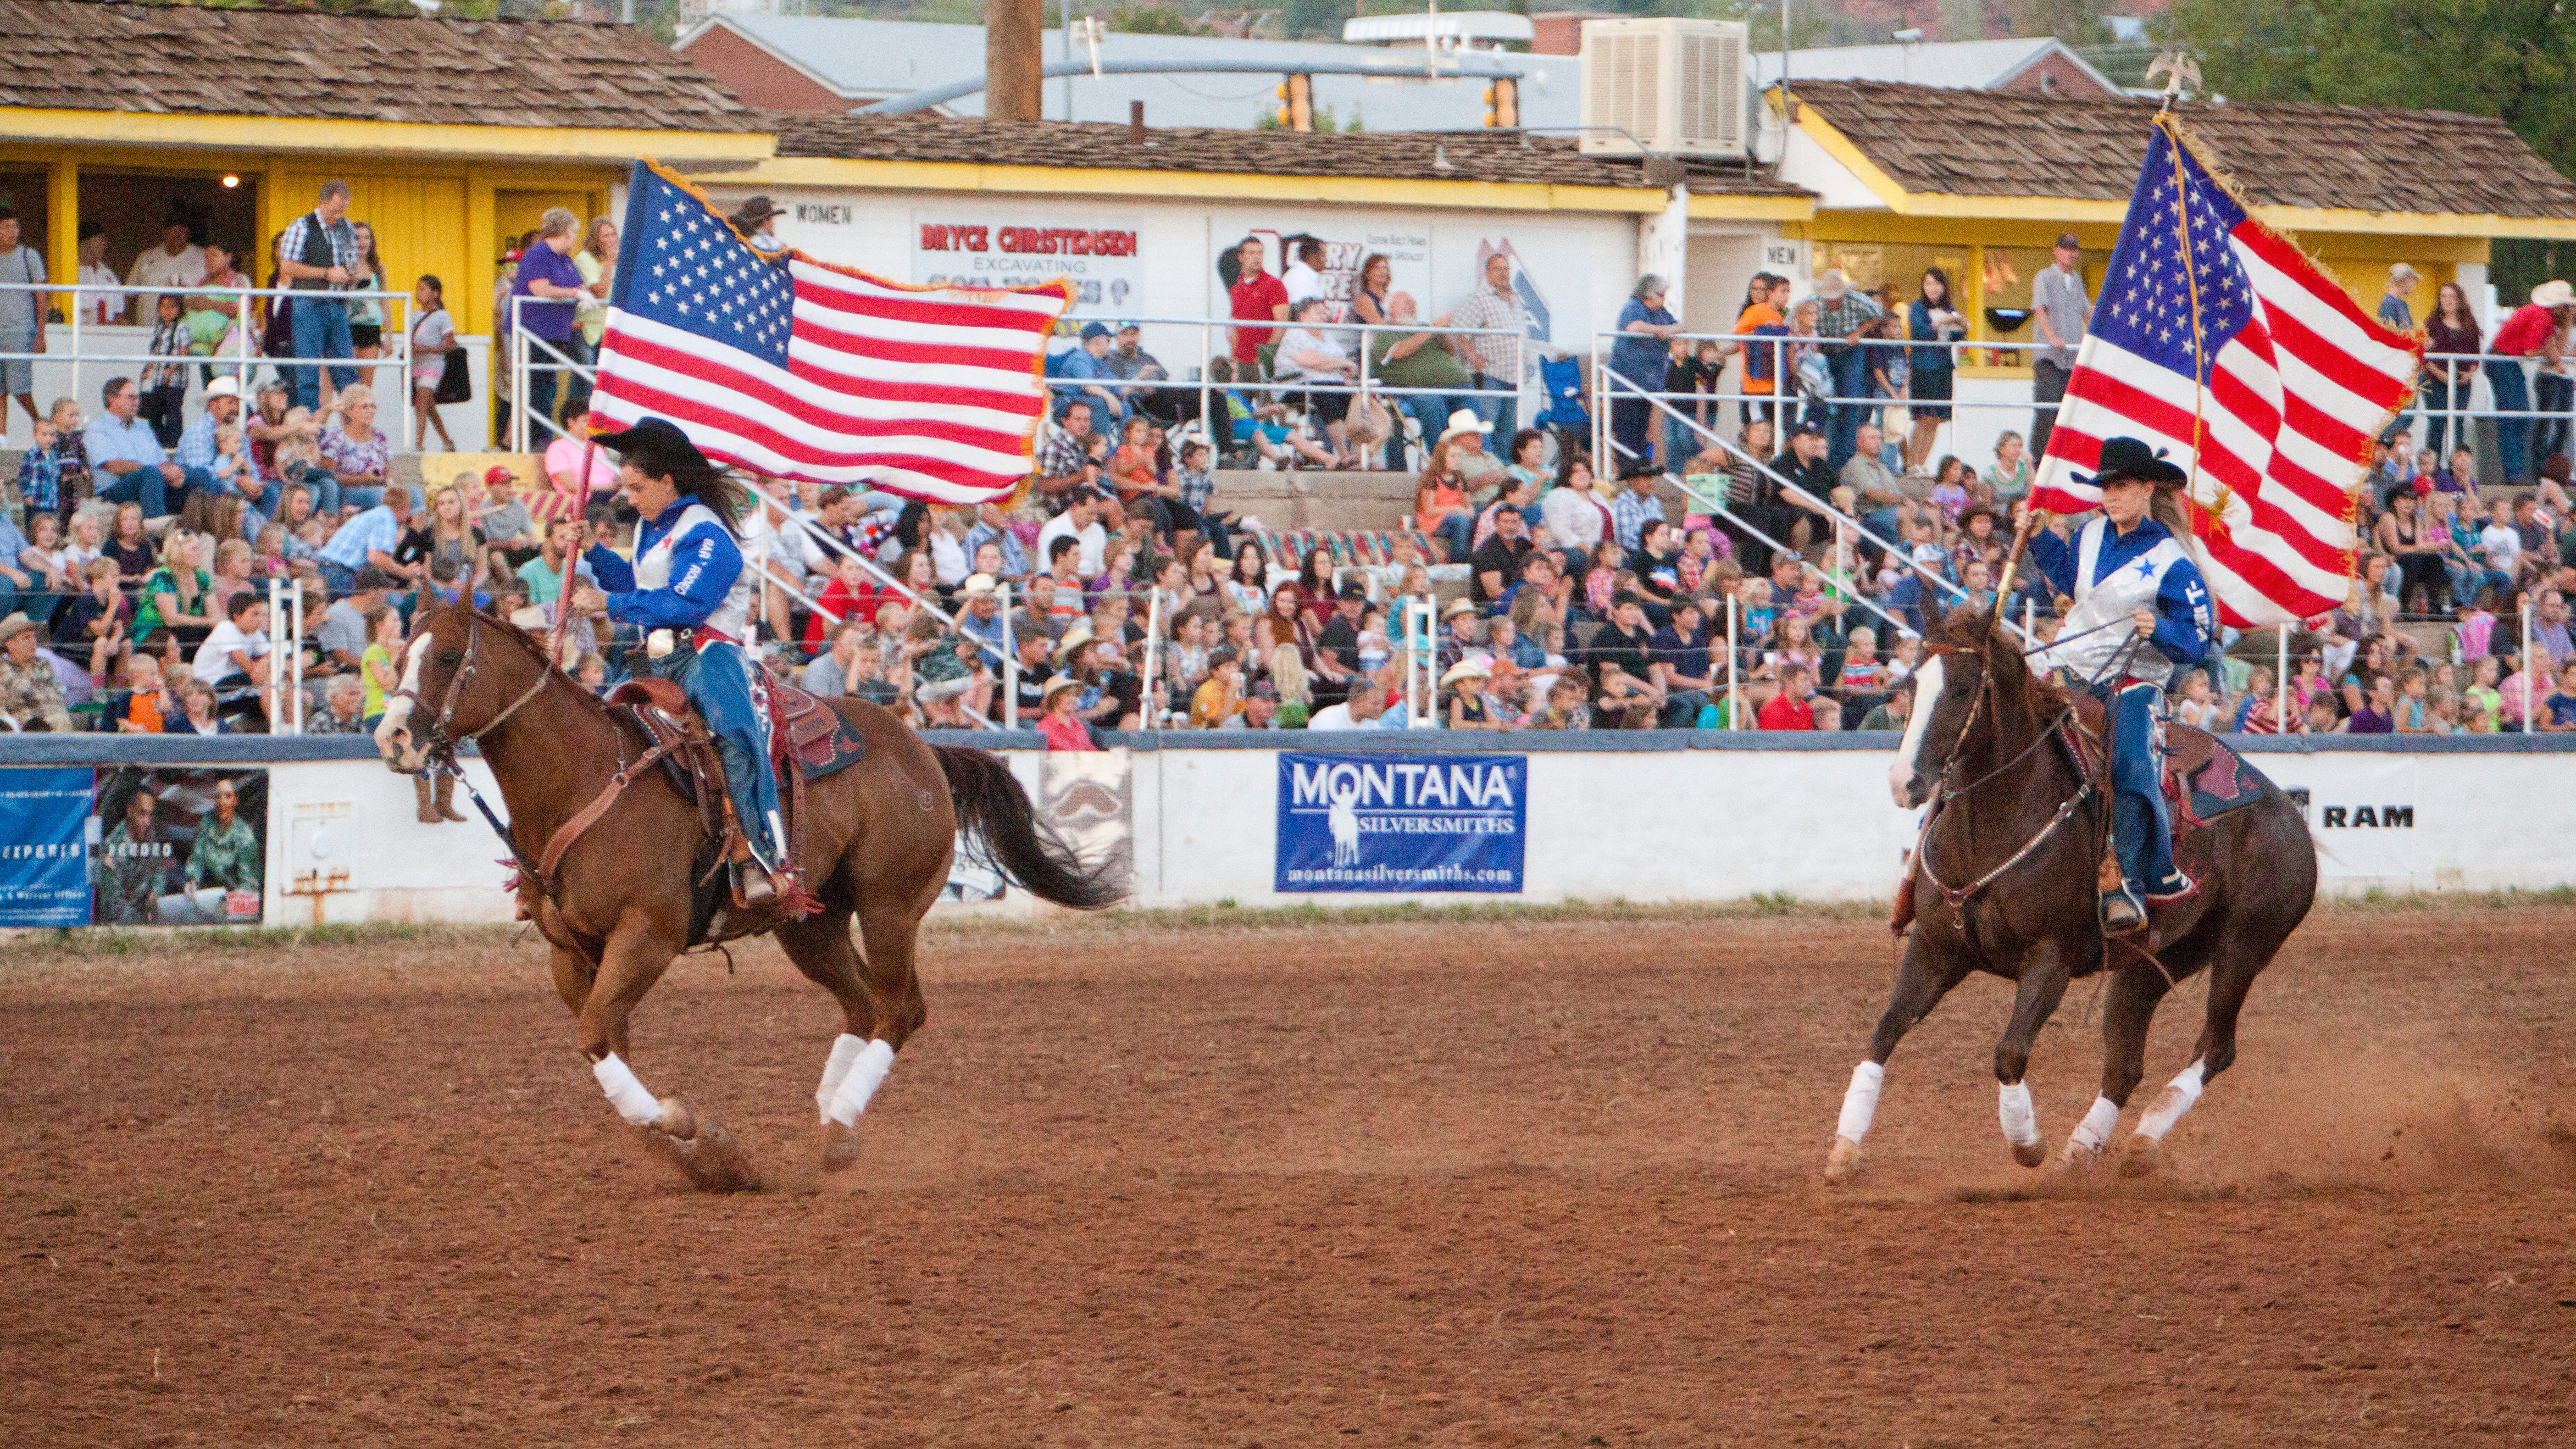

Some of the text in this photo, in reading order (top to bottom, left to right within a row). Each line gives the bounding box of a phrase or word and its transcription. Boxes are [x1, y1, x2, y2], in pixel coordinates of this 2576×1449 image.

[795, 204, 852, 224] WOMEN
[920, 223, 1138, 257] BRYCE CHRISTENSEN
[973, 257, 1088, 274] EXCAVATING
[1767, 246, 1796, 265] MEN
[673, 564, 702, 595] RODEO
[1292, 762, 1514, 806] MONTANA
[1358, 817, 1515, 834] SILVERSMITHS
[2322, 805, 2414, 827] RAM
[1287, 863, 1512, 882] montanasilversmiths.com
